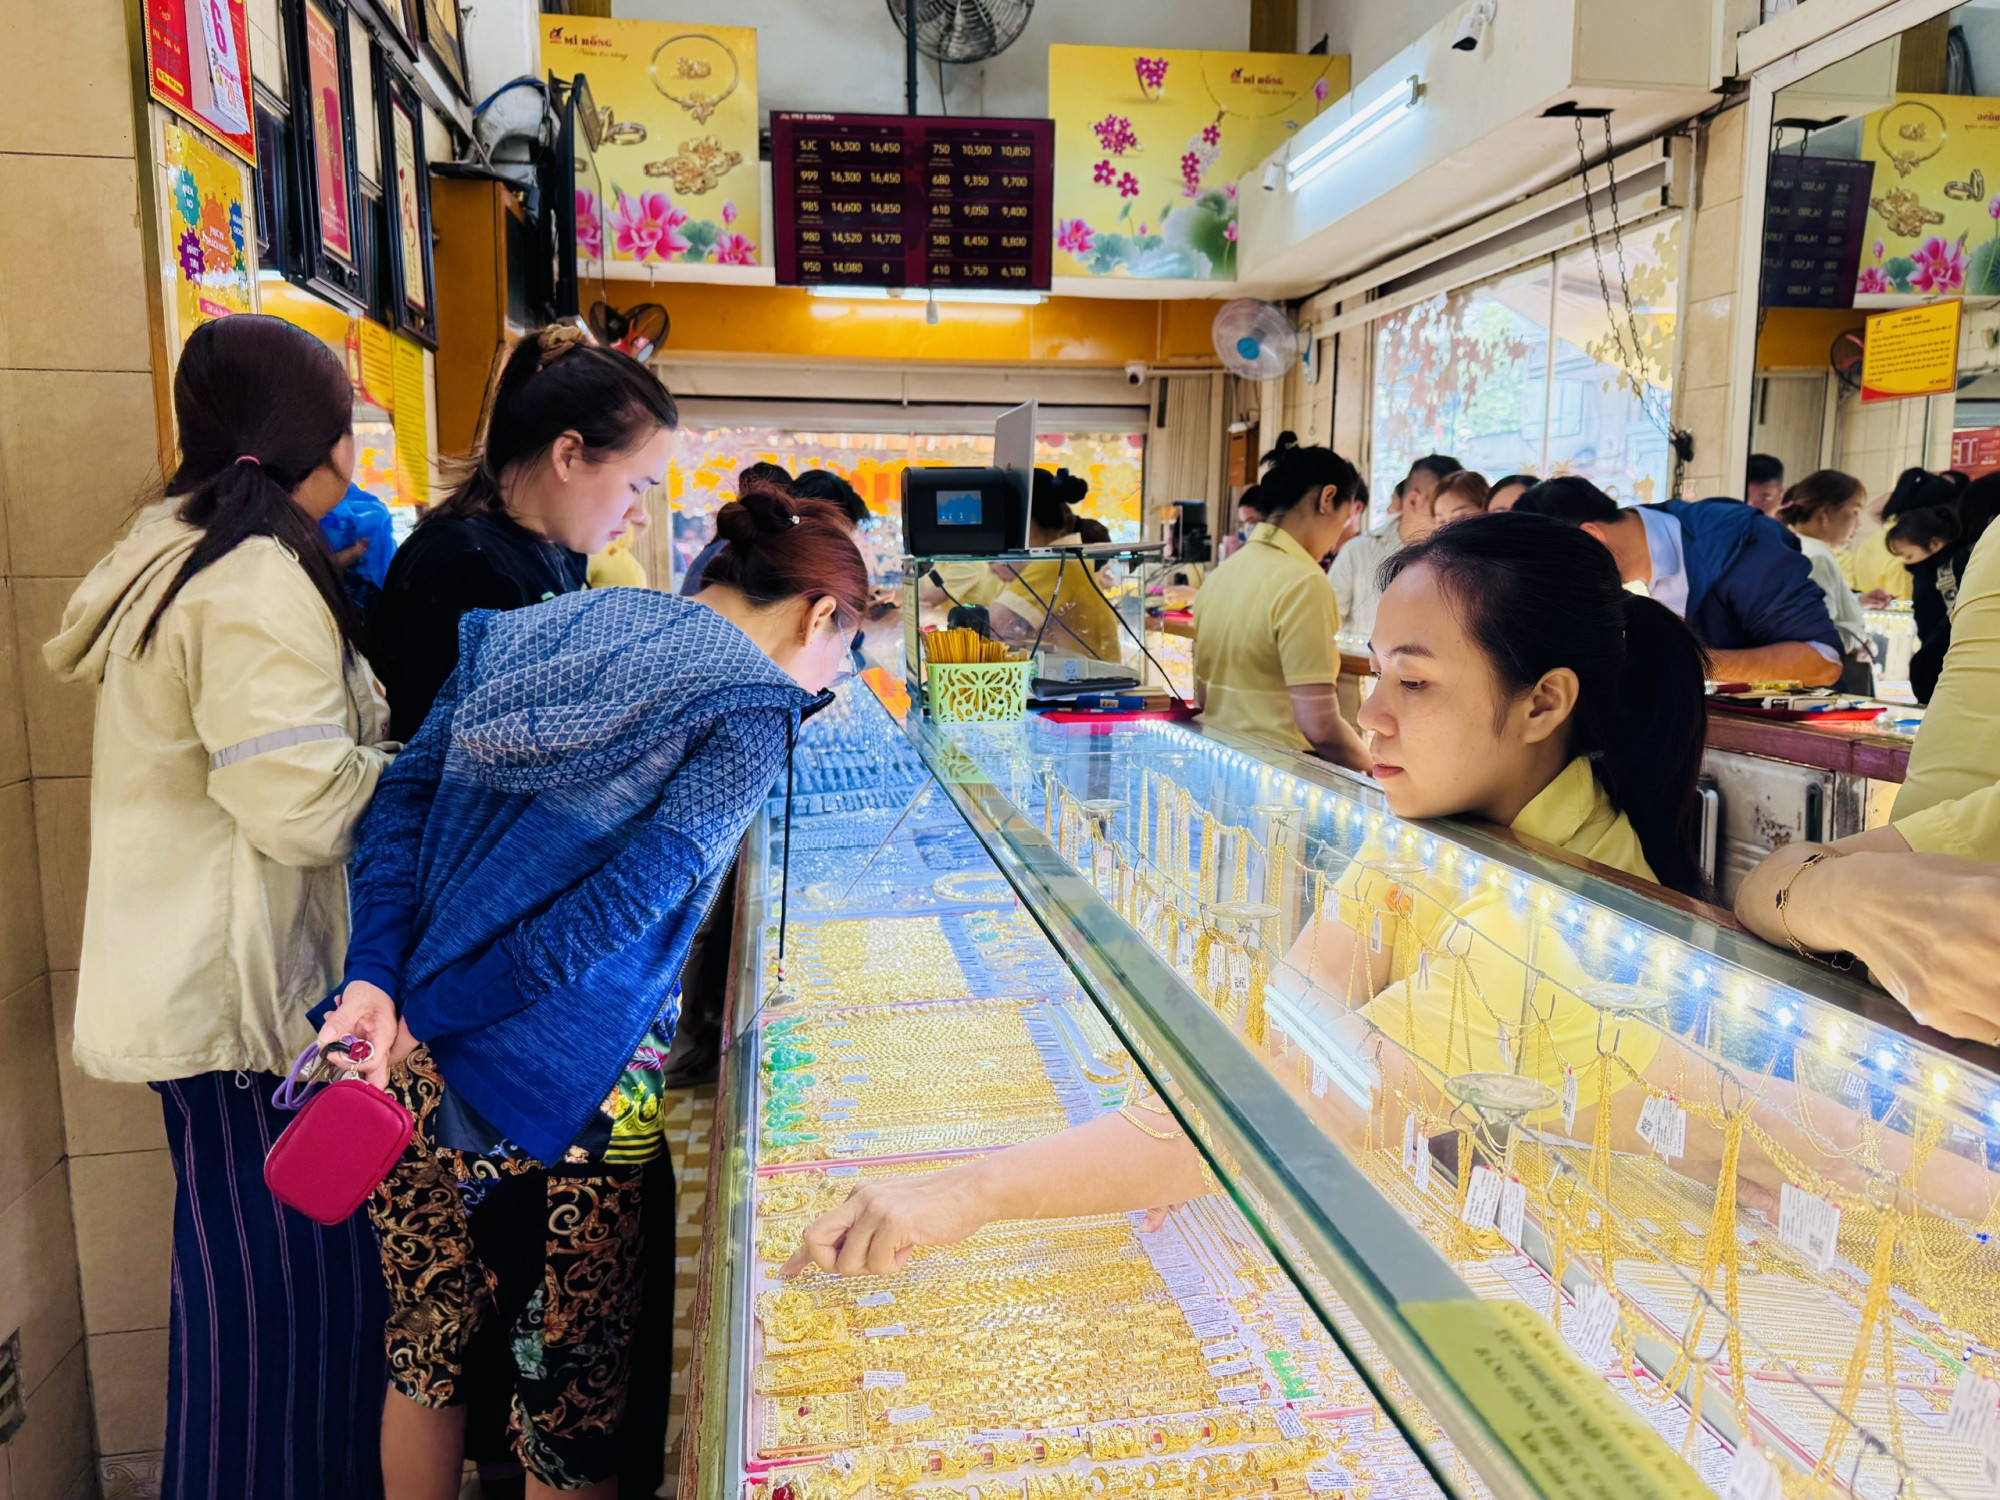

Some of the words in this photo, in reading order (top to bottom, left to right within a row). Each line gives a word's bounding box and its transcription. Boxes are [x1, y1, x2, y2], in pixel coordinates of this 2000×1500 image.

[800, 140, 818, 151] SJC
[830, 141, 861, 153] 16,300
[870, 142, 901, 154] 16,450
[933, 144, 951, 155] 750
[962, 145, 993, 157] 10,500
[1001, 145, 1031, 157] 10,850
[800, 170, 819, 181] 999
[831, 171, 862, 183] 16,300
[870, 172, 901, 184] 16,450
[931, 174, 951, 185] 680
[963, 174, 990, 187] 9,350
[1001, 176, 1028, 188] 9,700
[801, 201, 819, 212] 985
[831, 202, 862, 214] 14,600
[871, 203, 901, 215] 14,850
[931, 204, 951, 215] 610
[963, 205, 990, 217] 9,050
[1001, 206, 1028, 218] 9,400
[802, 231, 820, 242] 980
[832, 232, 863, 244] 14,520
[871, 233, 902, 245] 14,770
[932, 235, 951, 246] 580
[963, 235, 989, 247] 8,450
[802, 261, 821, 273] 950
[932, 264, 951, 275] 410
[963, 264, 989, 277] 5,750
[1001, 266, 1027, 278] 6,100
